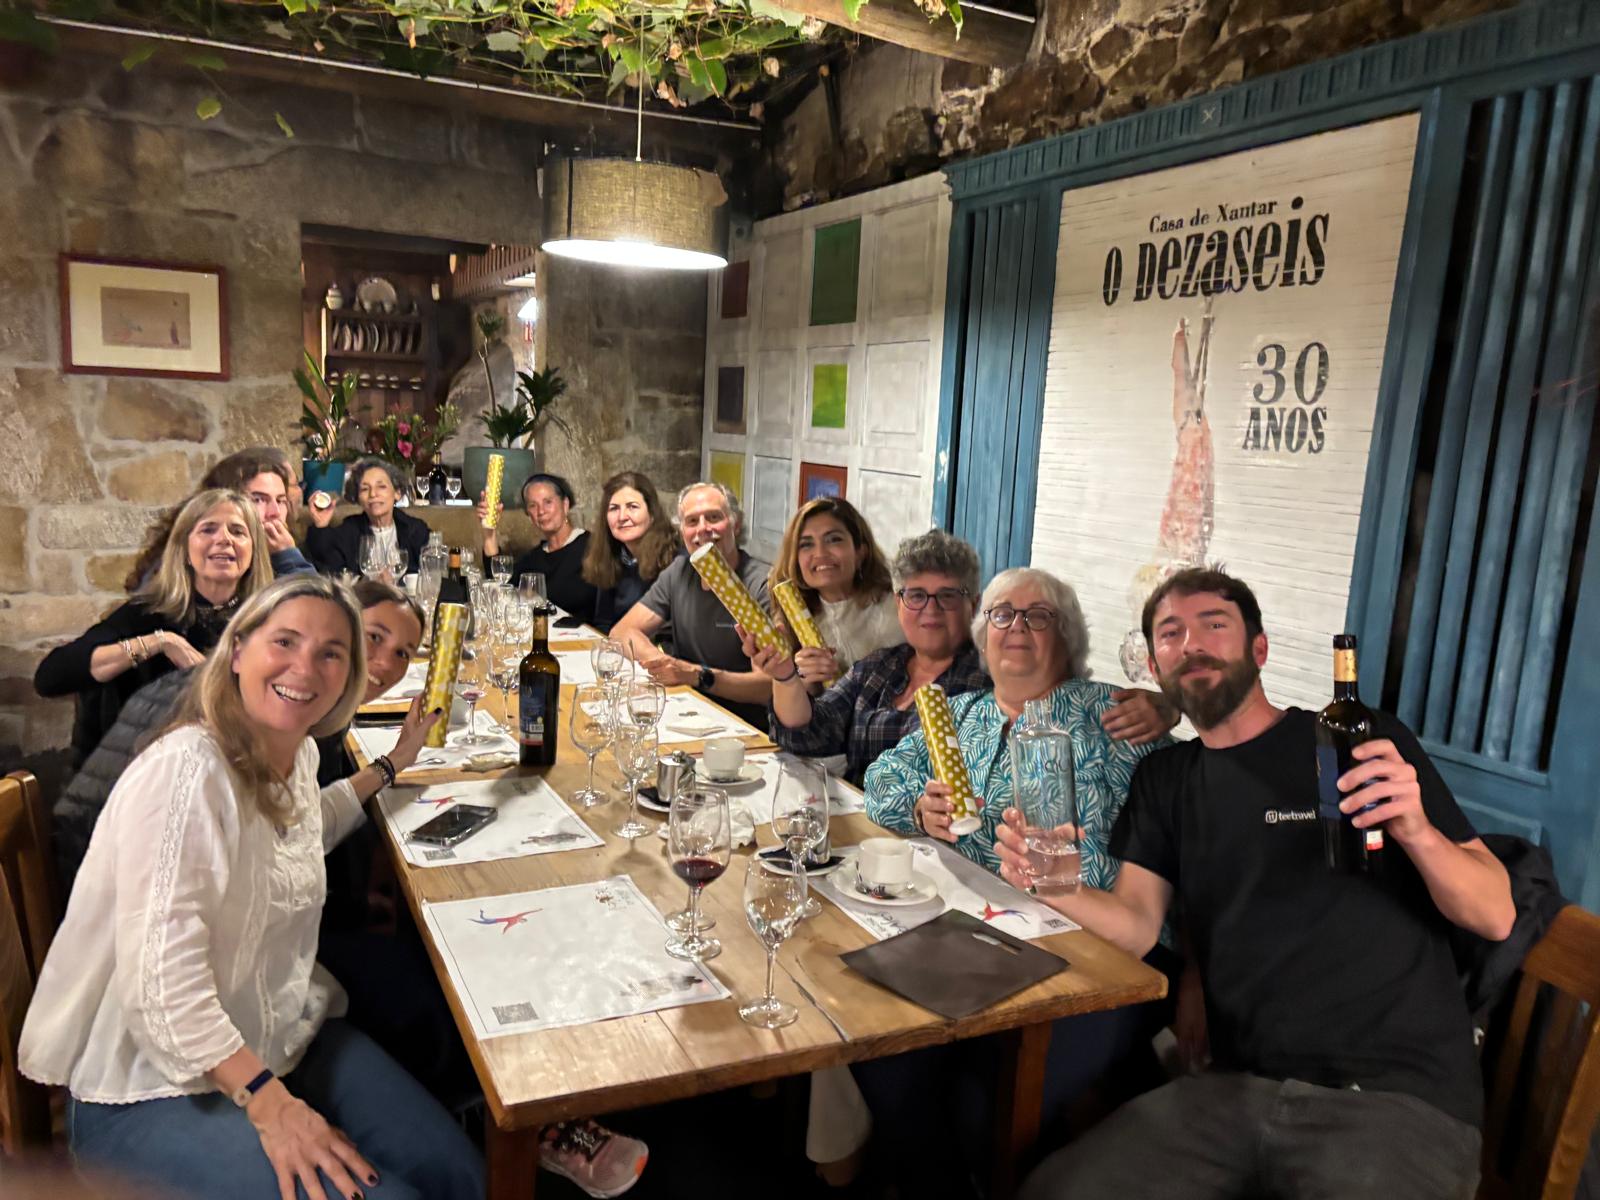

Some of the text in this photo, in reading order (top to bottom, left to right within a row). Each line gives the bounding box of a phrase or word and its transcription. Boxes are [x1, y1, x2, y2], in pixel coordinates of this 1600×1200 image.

[1149, 201, 1278, 233] Casa de Xantar
[1102, 196, 1330, 306] O Dezaseis
[1253, 342, 1330, 405] 30
[1242, 406, 1328, 454] ANOS
